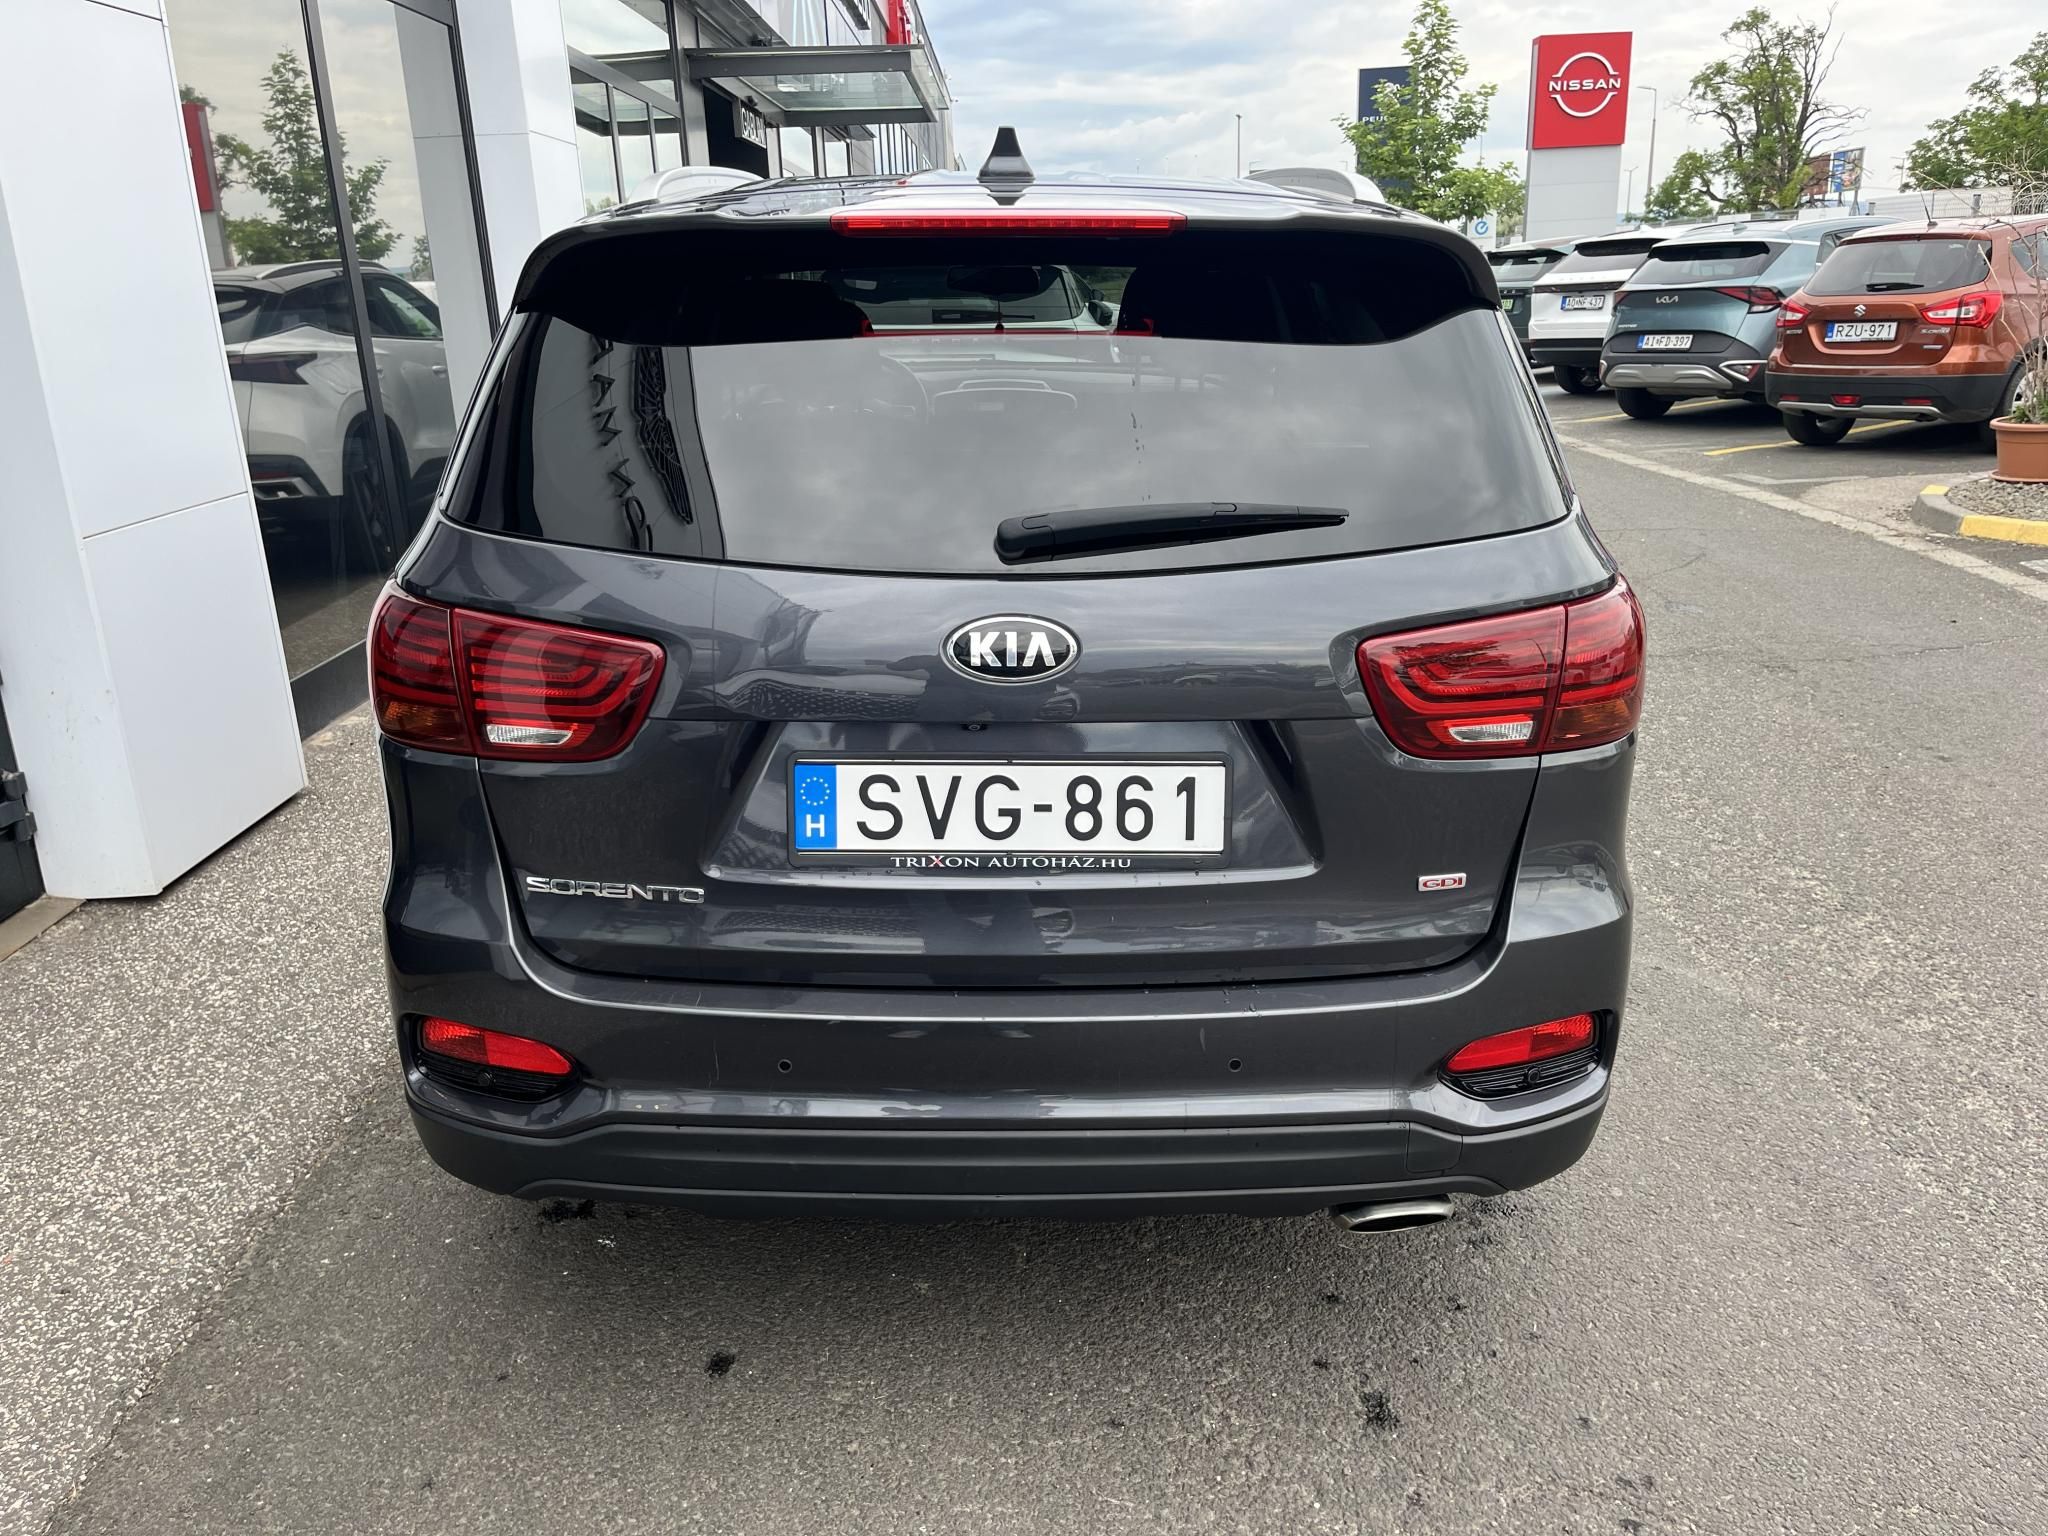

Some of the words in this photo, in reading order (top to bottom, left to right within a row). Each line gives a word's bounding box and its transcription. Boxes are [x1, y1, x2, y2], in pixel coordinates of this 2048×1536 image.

[1548, 78, 1621, 92] NISSAN
[1835, 324, 1892, 338] RZU-971
[969, 631, 1057, 667] KIA
[856, 774, 1197, 842] SVG-861
[806, 814, 825, 838] H
[890, 855, 980, 868] TRIXON
[987, 855, 1131, 868] AUTÓHÁZ.HU
[526, 876, 705, 904] SORENTO
[1422, 877, 1463, 889] GDI
